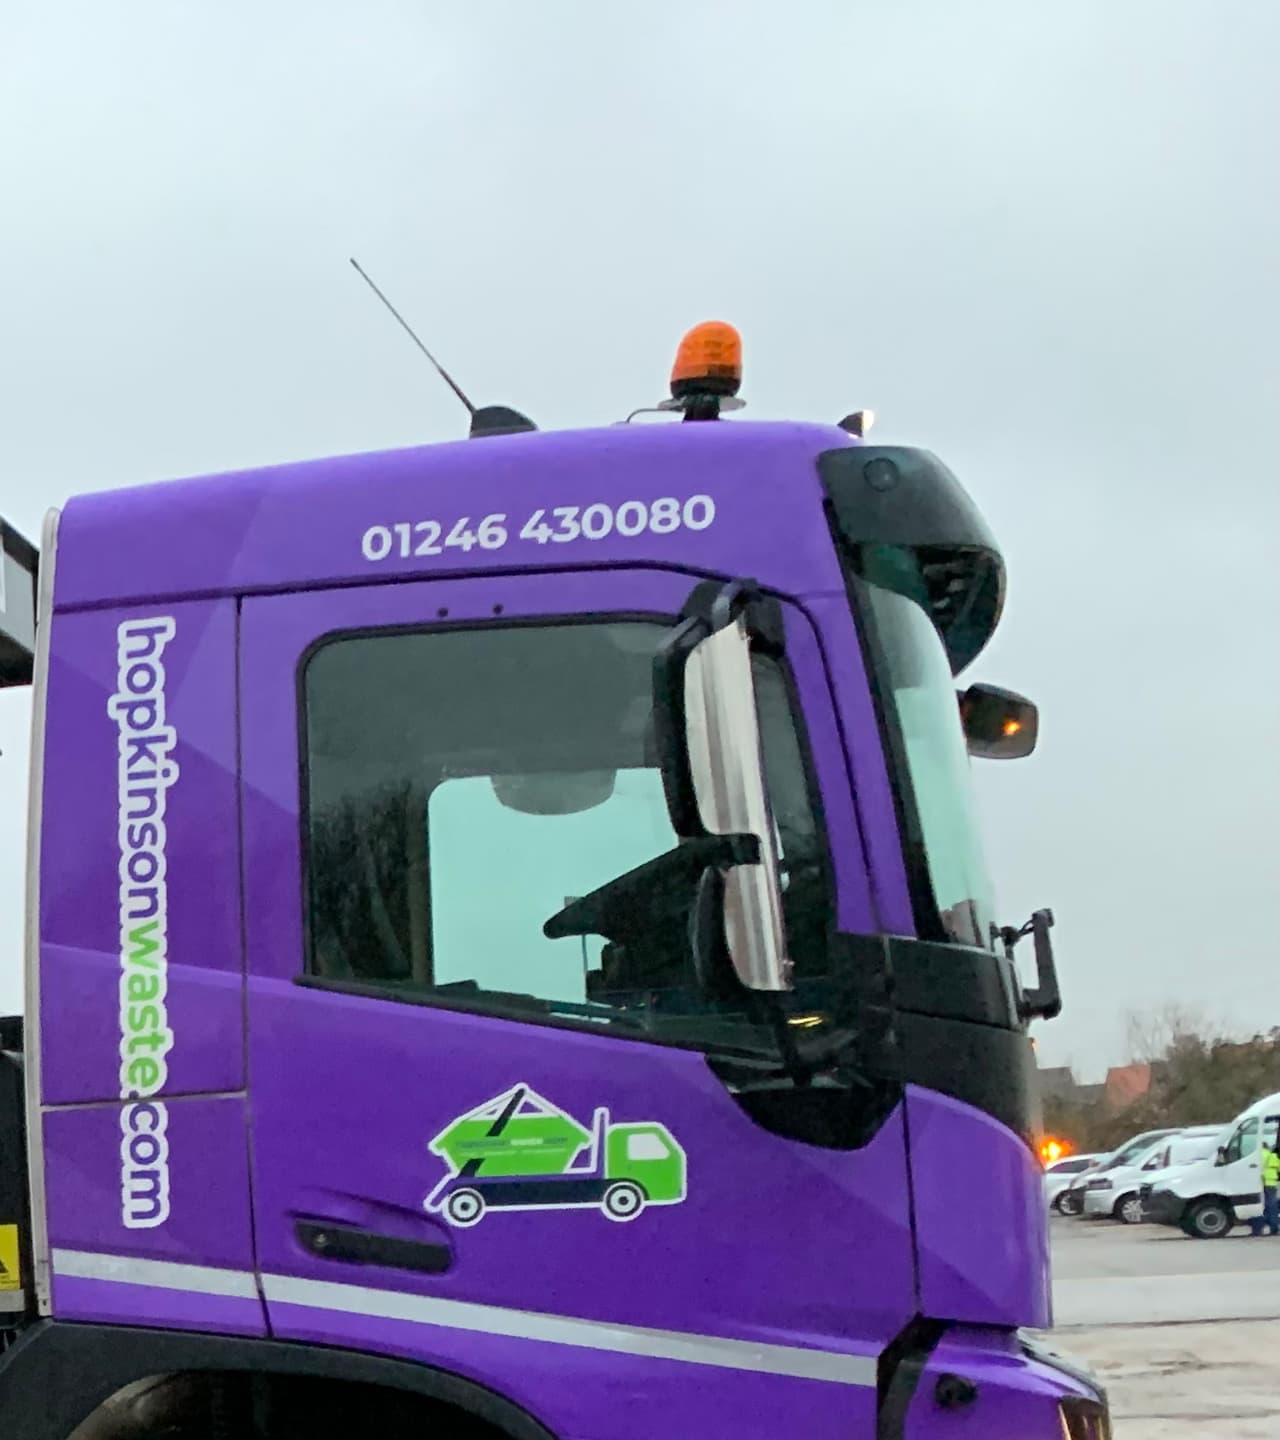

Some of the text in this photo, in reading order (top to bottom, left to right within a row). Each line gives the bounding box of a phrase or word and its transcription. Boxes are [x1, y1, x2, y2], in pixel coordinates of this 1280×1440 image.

[361, 494, 716, 562] 01246 430080
[112, 621, 175, 1224] hopkinsonwaste.com
